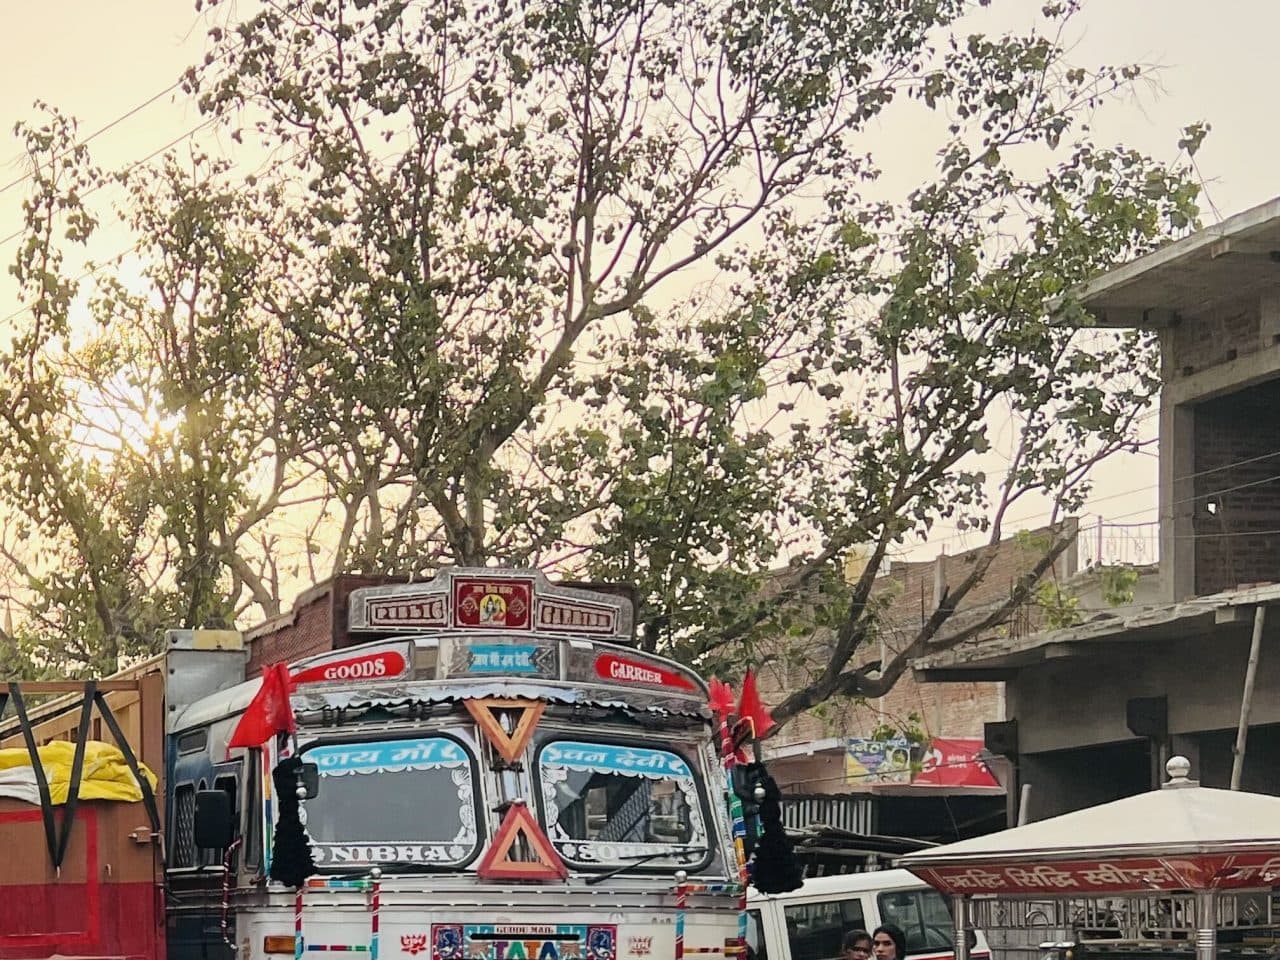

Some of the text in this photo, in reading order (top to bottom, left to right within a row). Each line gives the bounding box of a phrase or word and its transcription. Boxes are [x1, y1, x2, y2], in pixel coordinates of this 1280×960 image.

[324, 658, 385, 680] GOODS
[610, 661, 662, 684] CARRIER
[330, 846, 451, 862] NIBHA
[493, 941, 558, 960] TATA
